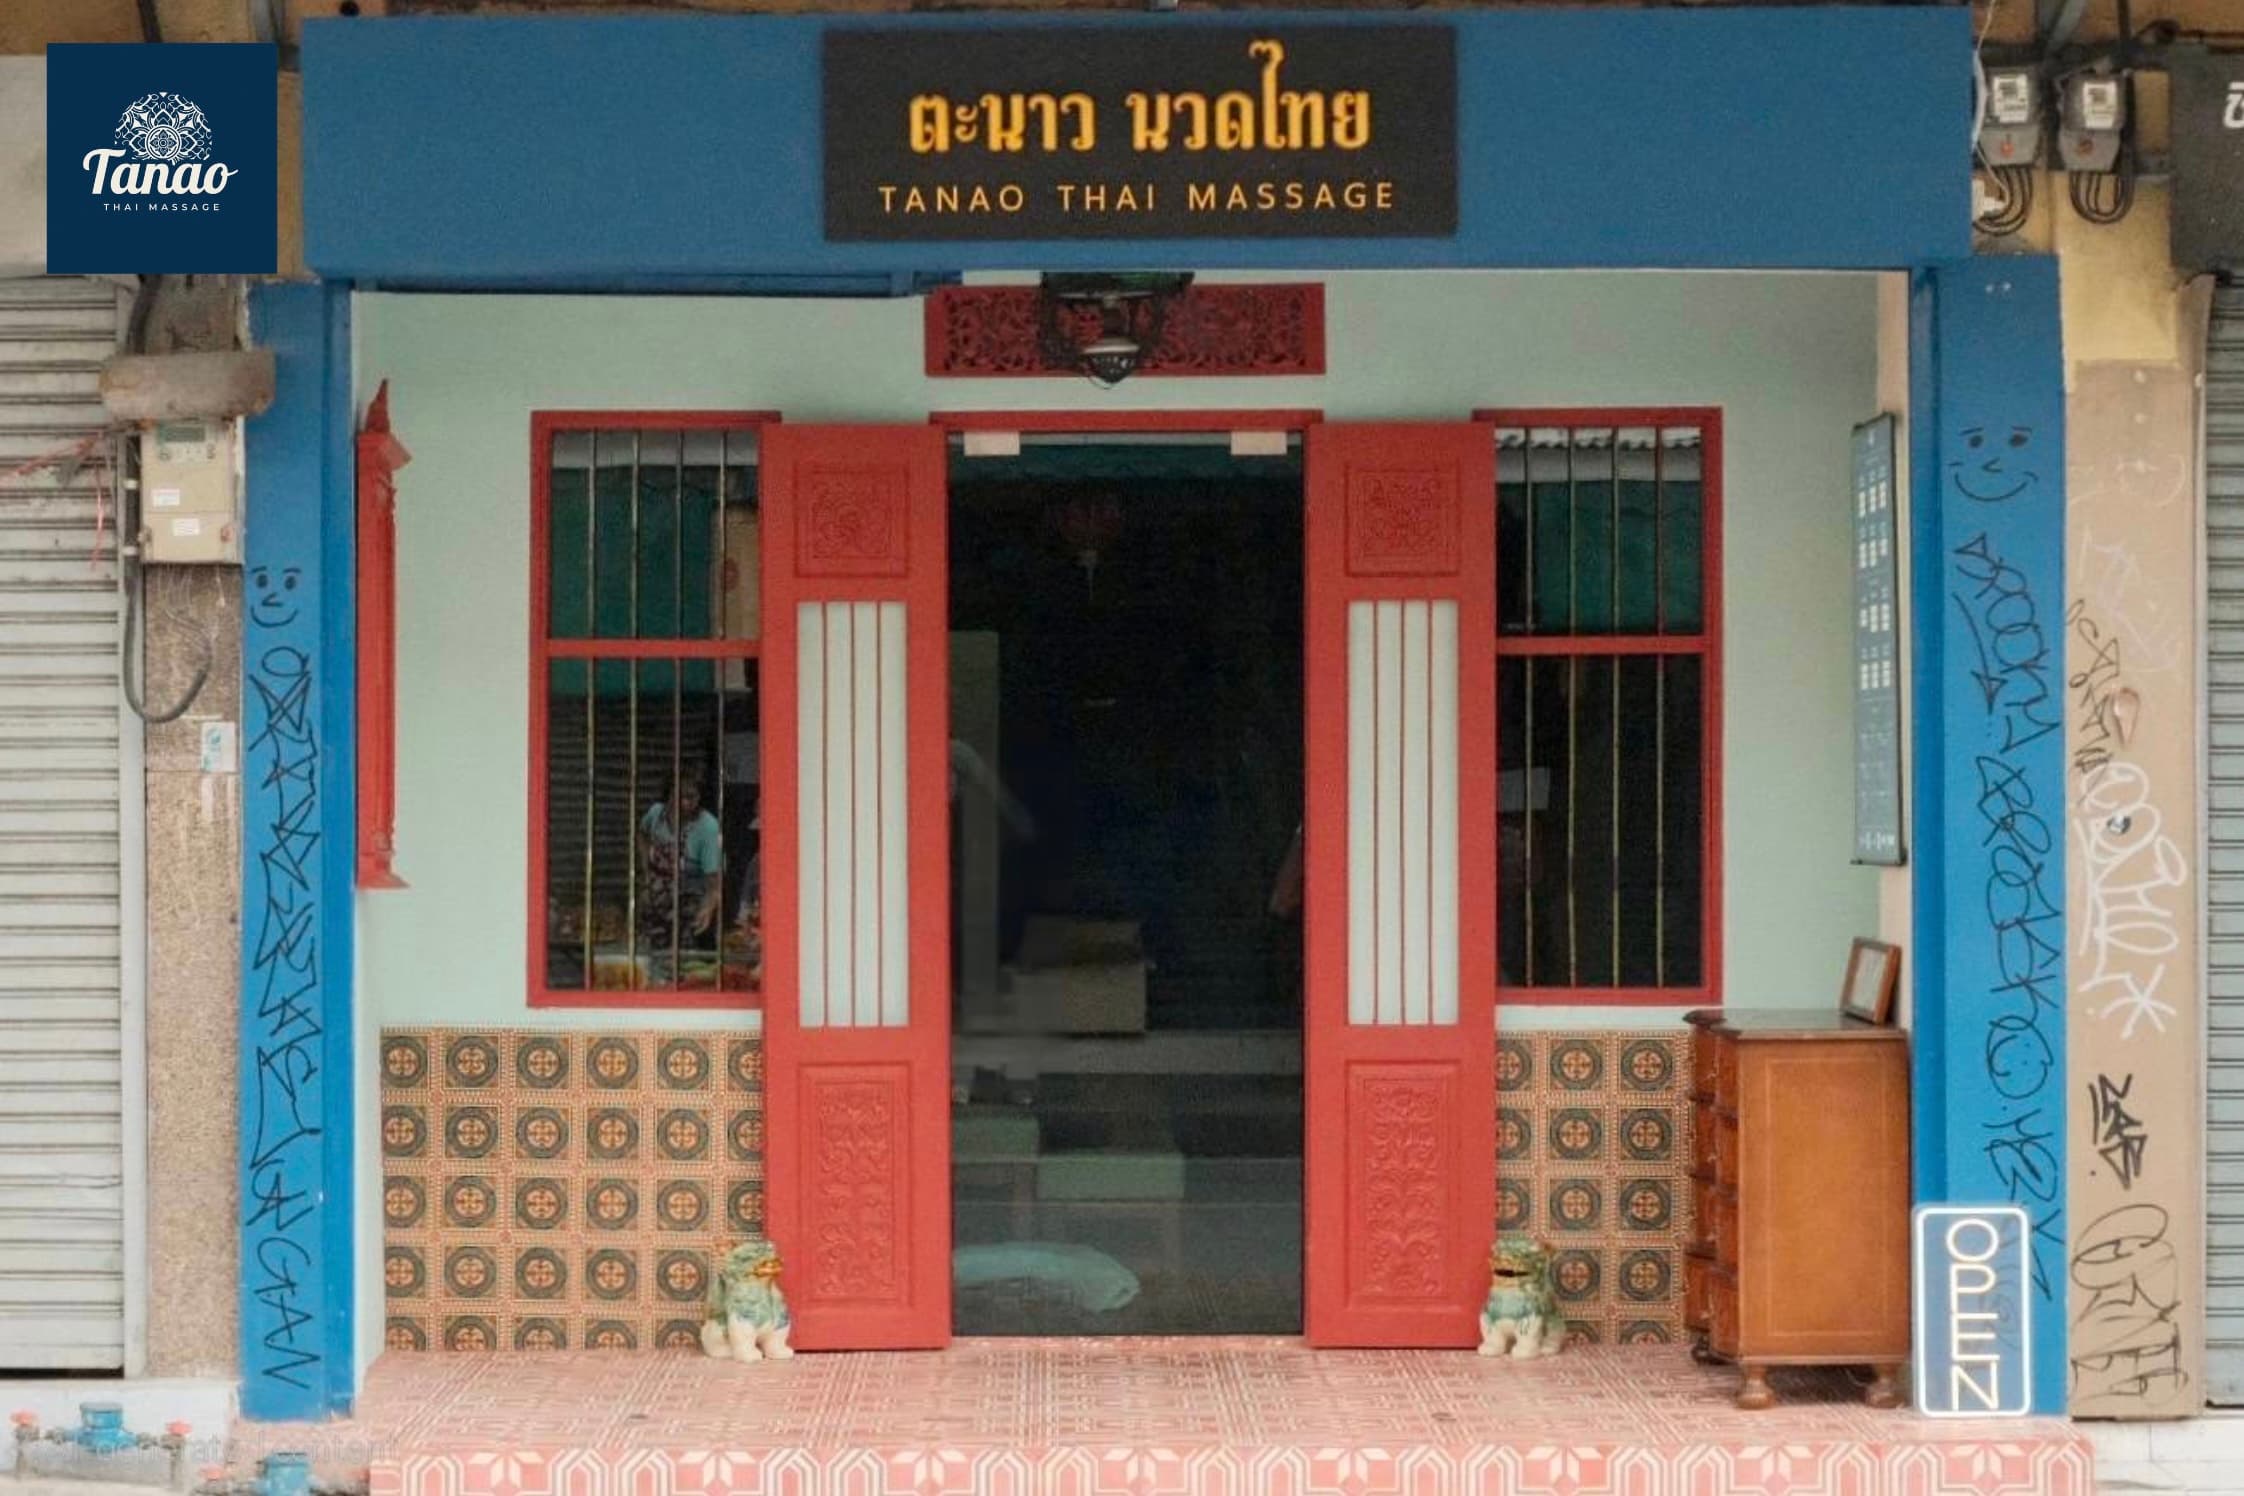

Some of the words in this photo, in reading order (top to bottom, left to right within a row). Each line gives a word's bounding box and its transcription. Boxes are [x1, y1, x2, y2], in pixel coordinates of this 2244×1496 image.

[908, 92, 1097, 154] ตะนาว
[1125, 39, 1371, 152] นวดไทย
[878, 184, 1025, 214] TANAO
[1057, 184, 1155, 212] THAI
[1188, 181, 1393, 211] MASSAGE
[1945, 1218, 1999, 1412] OPEN
